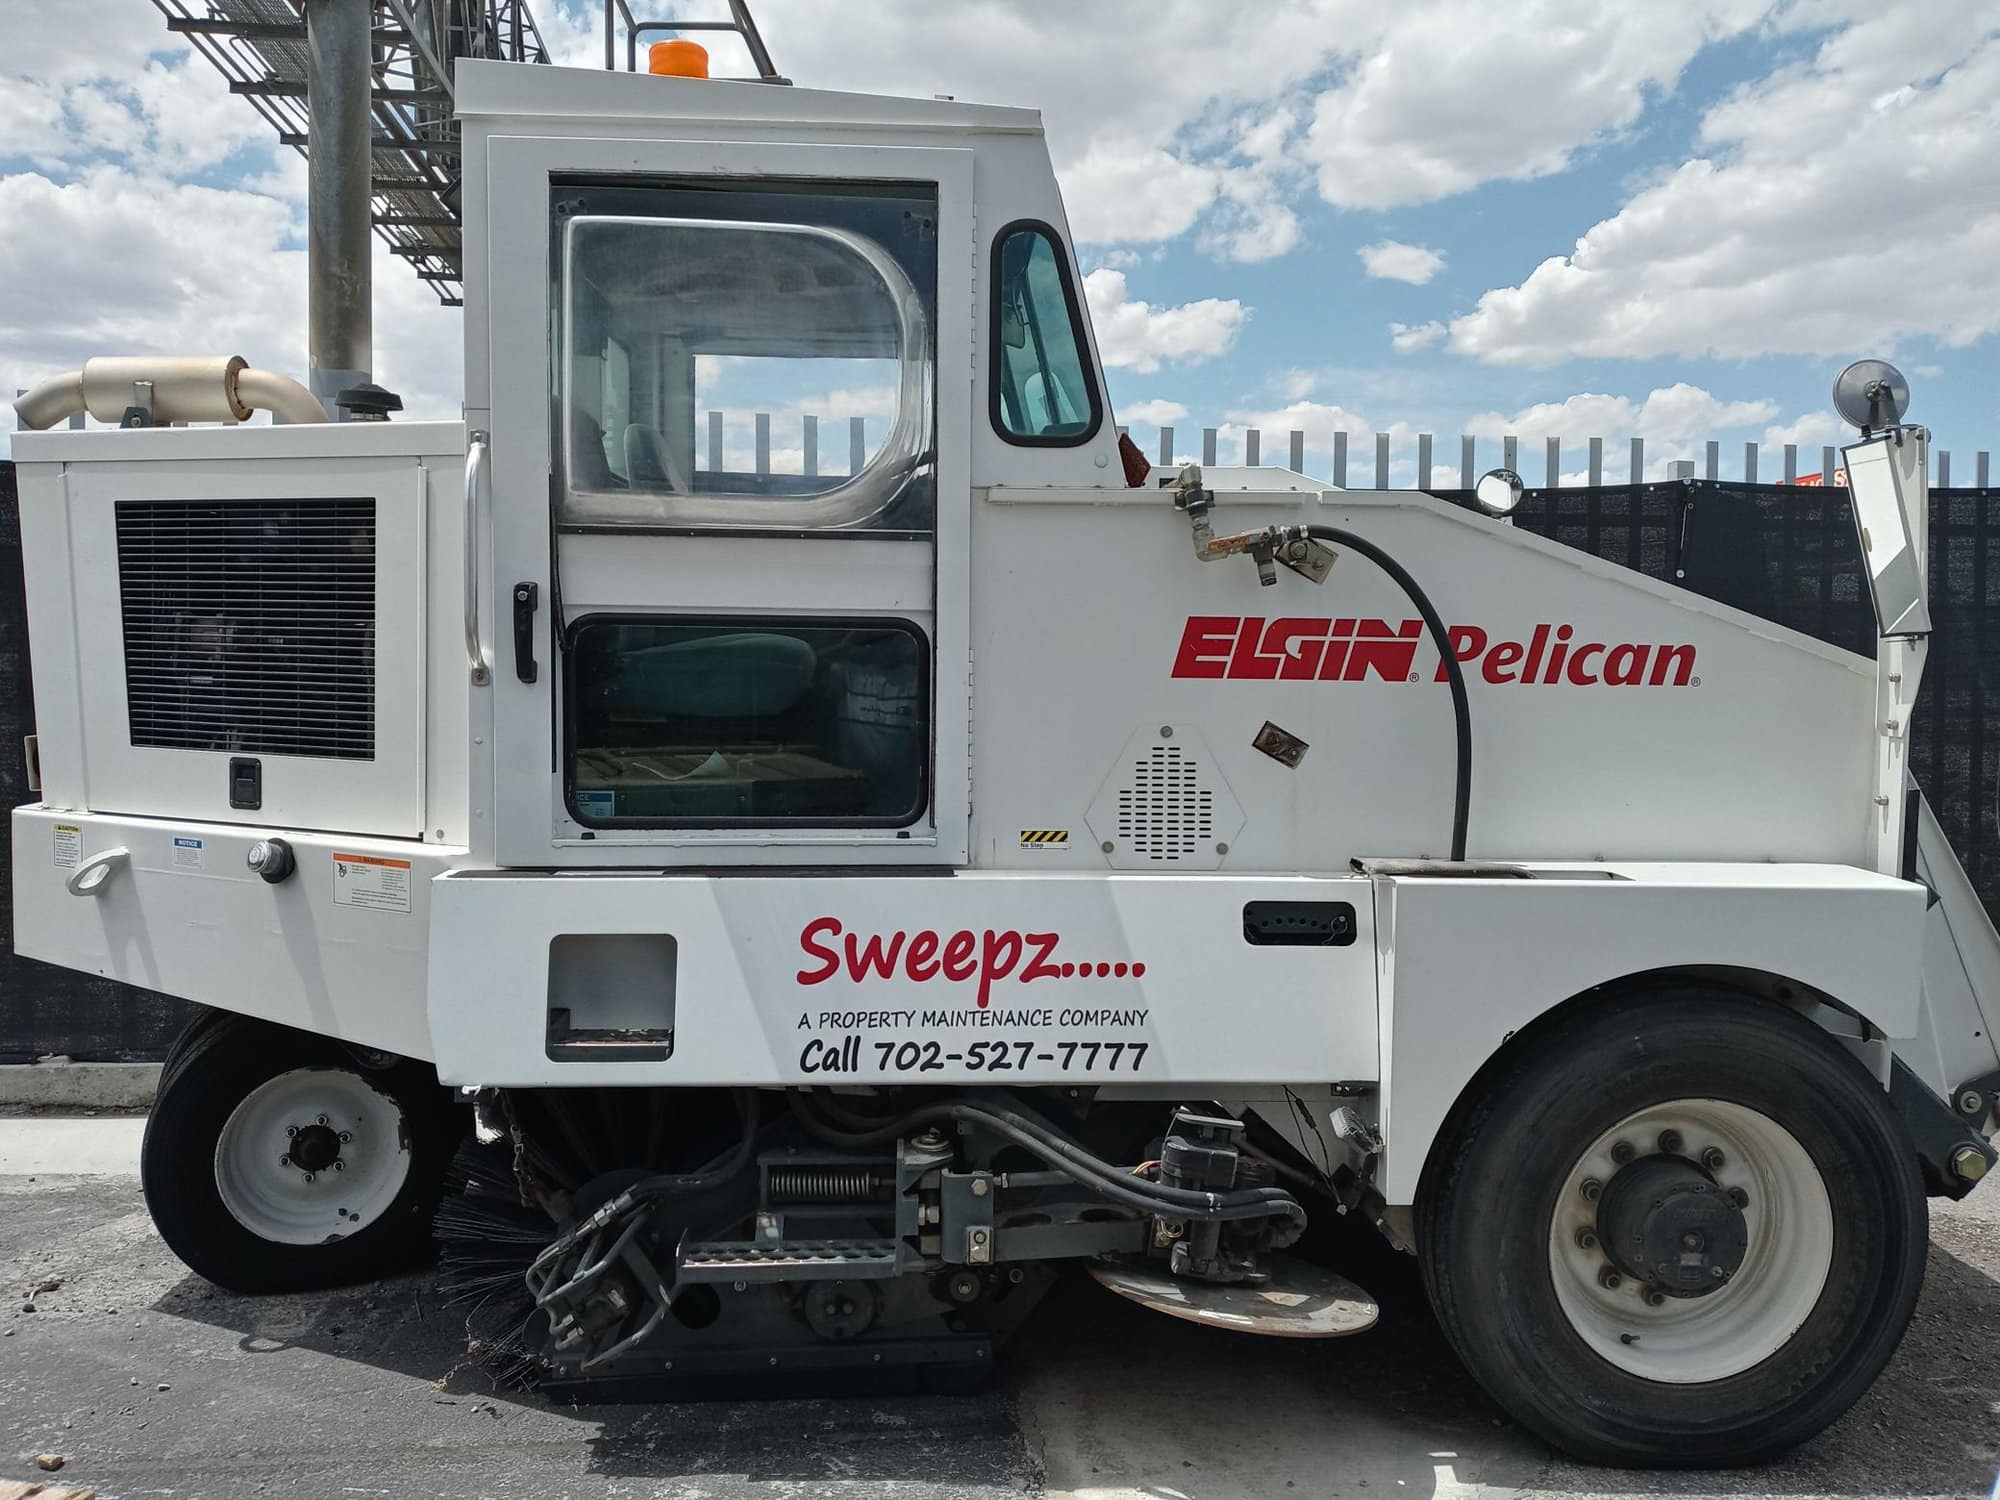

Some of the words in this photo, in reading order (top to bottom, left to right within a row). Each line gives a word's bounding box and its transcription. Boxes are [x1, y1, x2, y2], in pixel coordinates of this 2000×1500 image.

[798, 1012, 812, 1029] A
[819, 1009, 917, 1029] PROPERTY
[921, 1008, 1053, 1028] MAINTENANCE
[1059, 1008, 1149, 1027] COMPANY
[799, 1034, 862, 1074] Call
[874, 1040, 1149, 1073] 702-527-7777
